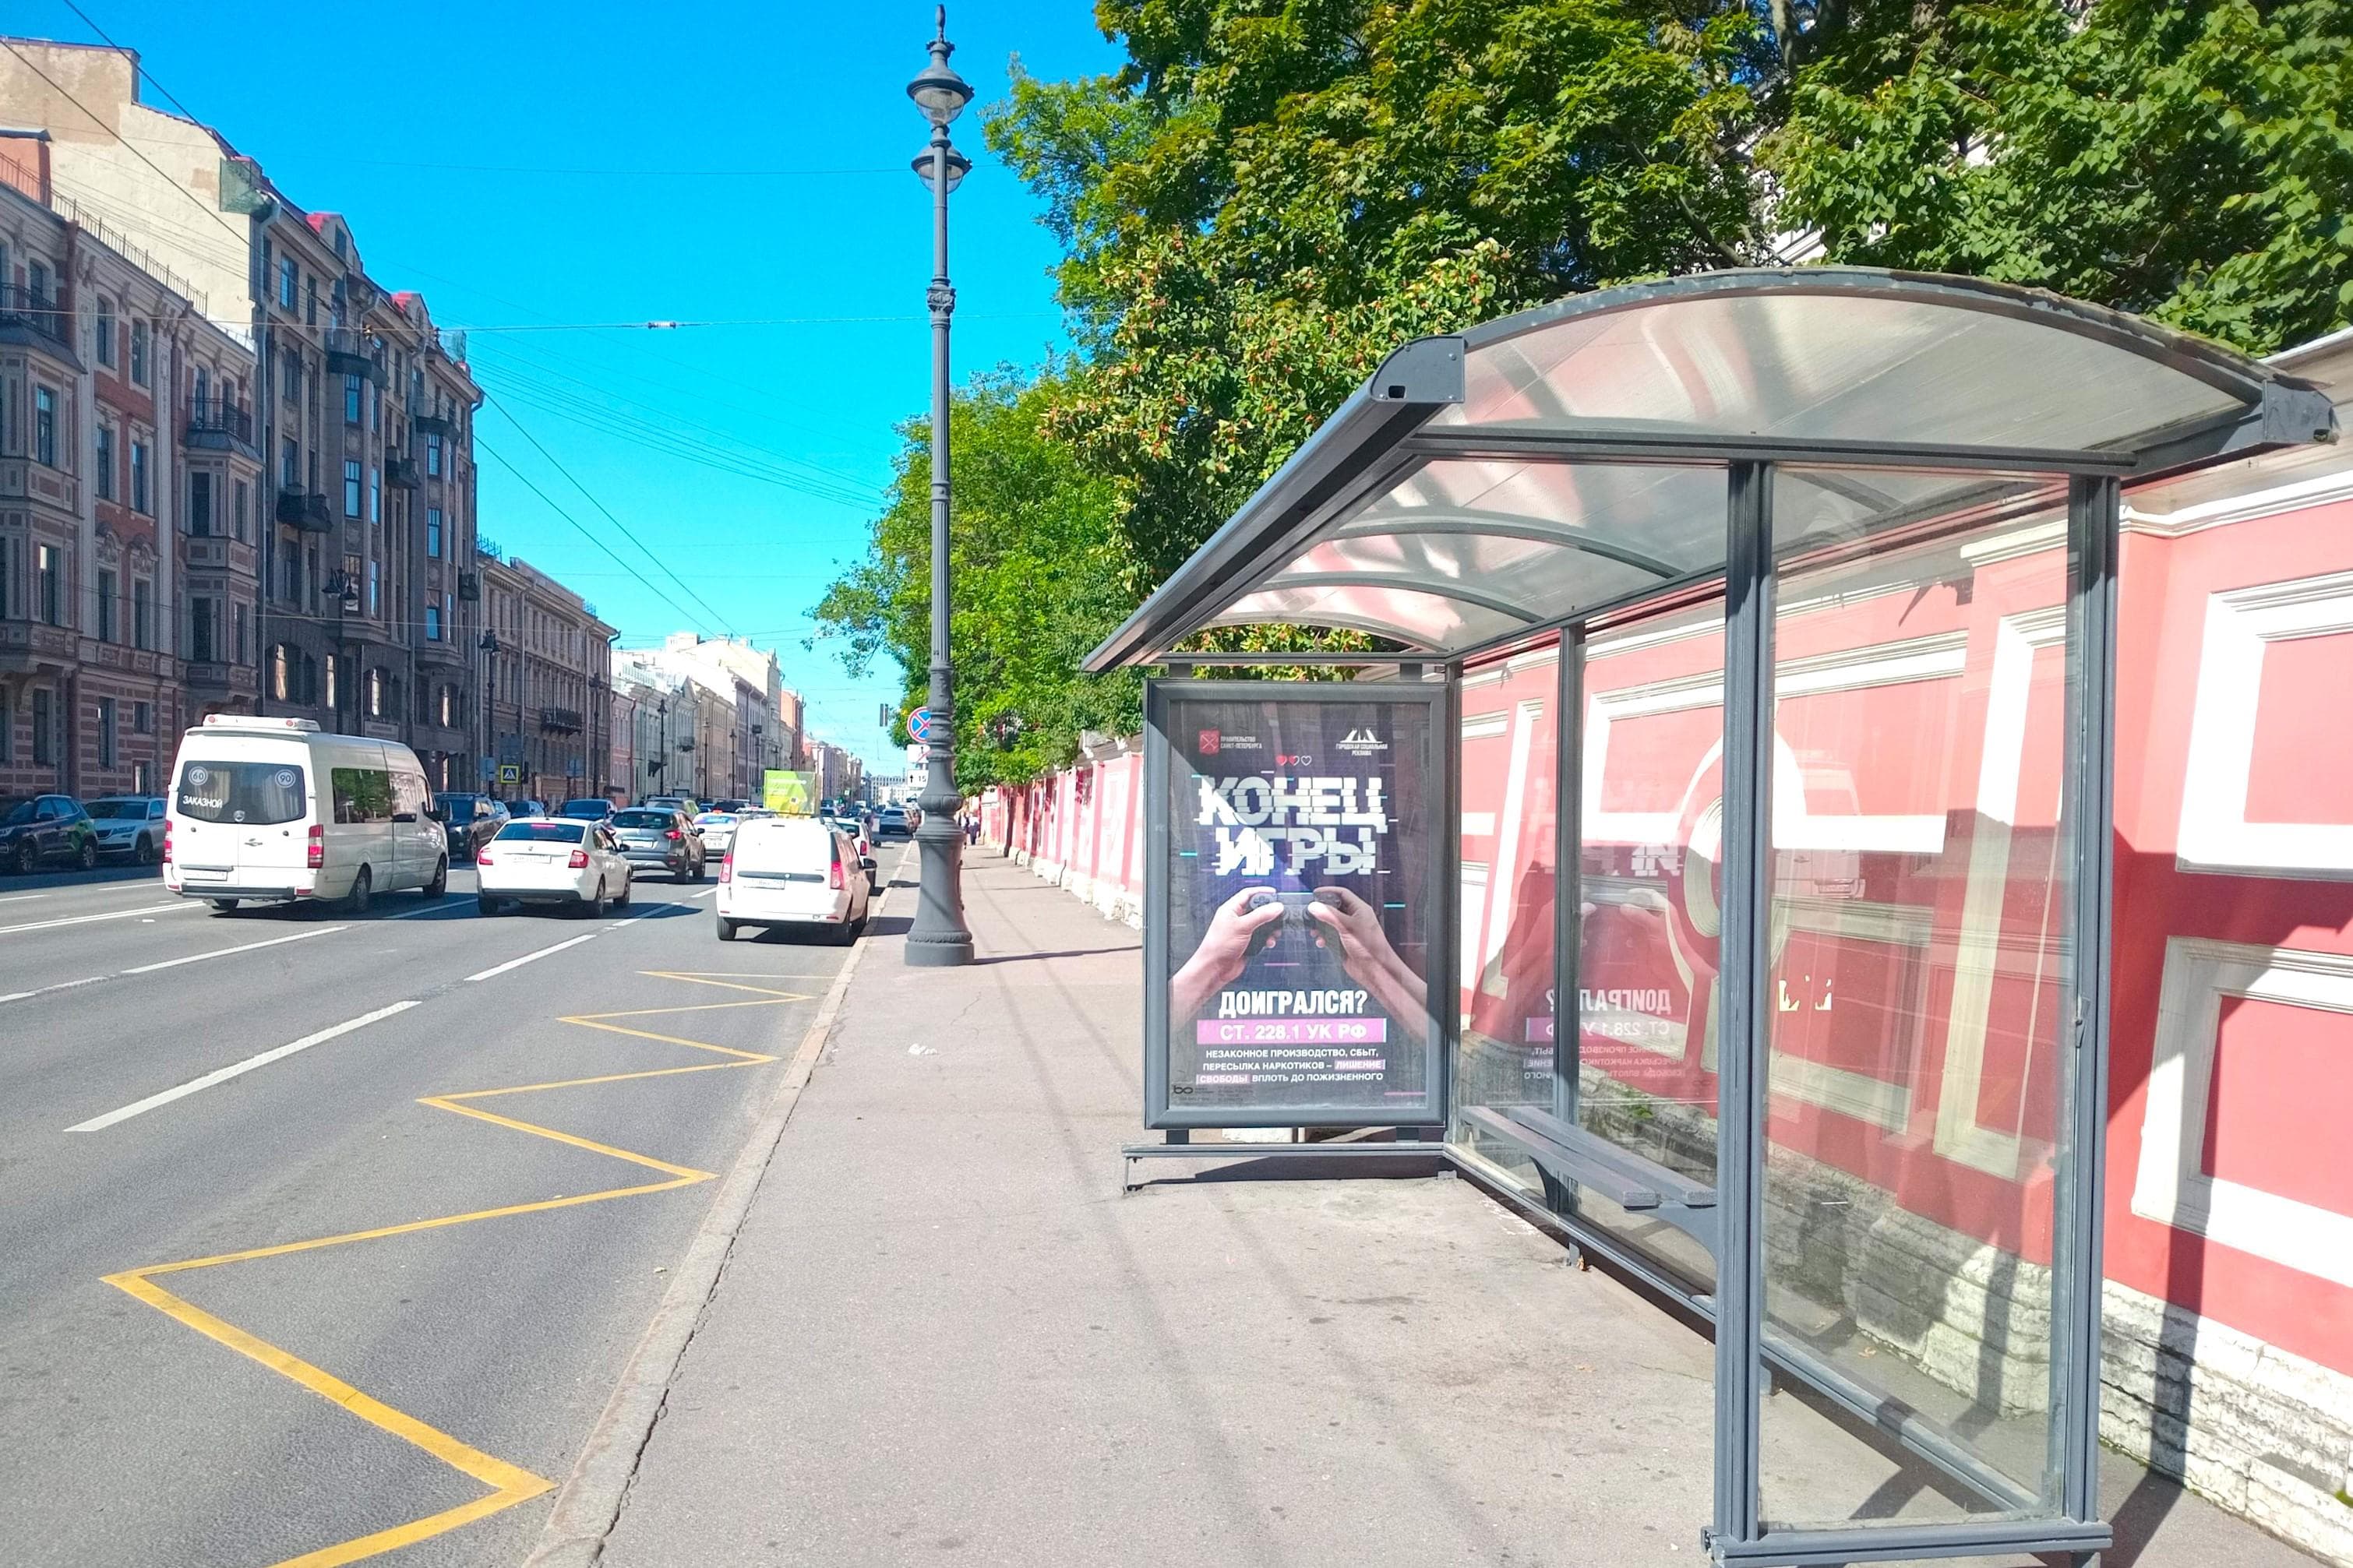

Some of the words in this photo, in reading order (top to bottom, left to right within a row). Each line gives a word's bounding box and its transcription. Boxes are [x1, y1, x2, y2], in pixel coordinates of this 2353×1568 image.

[182, 795, 223, 809] ЗАКАЗНОЙ
[1198, 777, 1388, 833] КОНЕЦ
[1215, 827, 1376, 876] ИГРЫ
[1219, 990, 1368, 1019] ДОИГРАЛСЯ?
[1220, 1024, 1250, 1041] СТ.
[1255, 1024, 1299, 1040] 228.1
[1306, 1024, 1332, 1039] УК
[1339, 1023, 1367, 1039] РФ
[1205, 1049, 1268, 1059] НЕЗАКОННОЕ
[1271, 1048, 1348, 1059] ПРОИЗВОДСТВО,
[1349, 1048, 1379, 1057] СБЫТ,
[1203, 1062, 1260, 1071] ПЕРЕСЫЛКА
[1262, 1062, 1325, 1070] НАРКОТИКОВ
[1335, 1060, 1381, 1069] ЛИШЕНИЕ
[1199, 1075, 1248, 1084] СВОБОДЫ
[1252, 1074, 1289, 1083] ВПЛОТЬ
[1291, 1073, 1304, 1083] ДО
[1307, 1073, 1384, 1081] ПОЖИЗНЕННОГО
